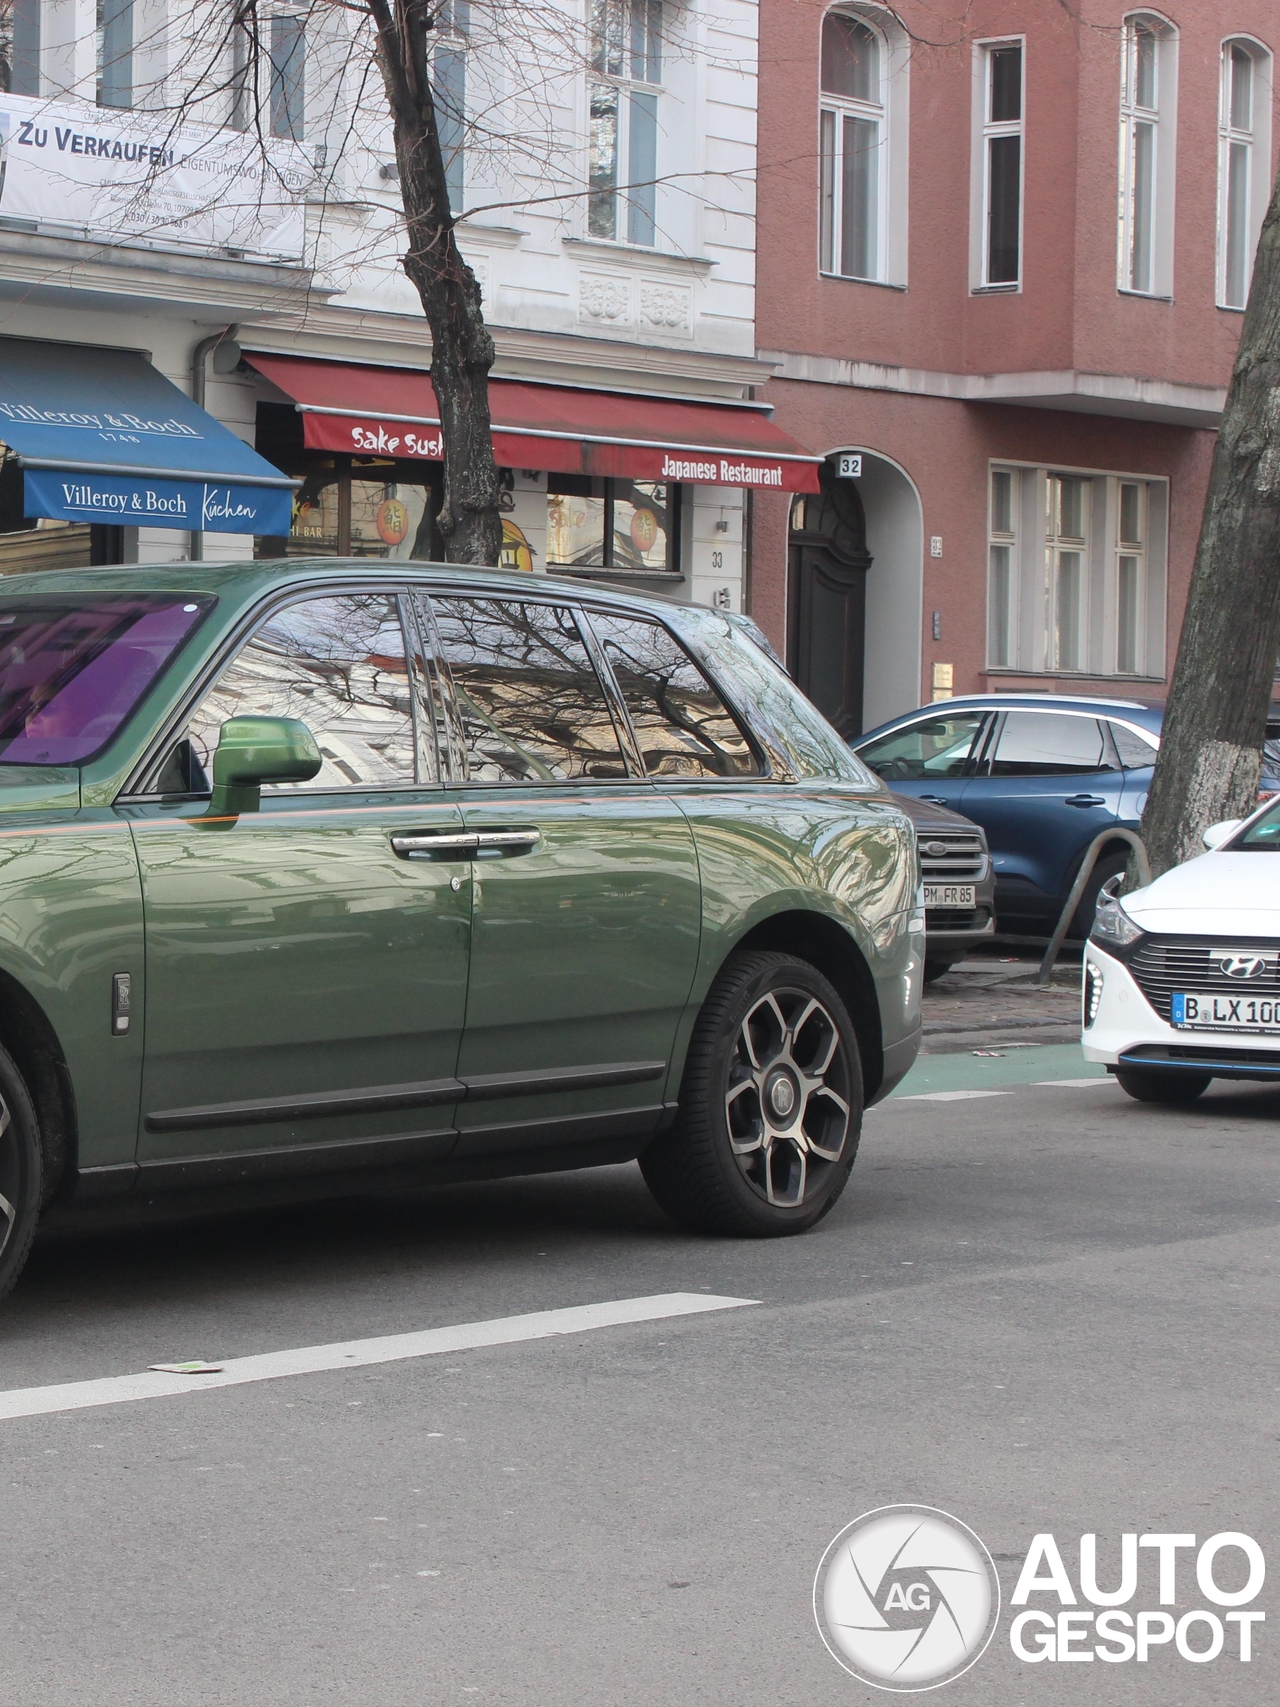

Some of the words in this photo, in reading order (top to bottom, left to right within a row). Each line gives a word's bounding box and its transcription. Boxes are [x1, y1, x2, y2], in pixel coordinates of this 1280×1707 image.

[18, 121, 48, 148] ZU
[55, 126, 175, 167] VERKAUFEN
[105, 412, 123, 429] &
[120, 412, 199, 436] Boch
[98, 432, 141, 445] 1748
[351, 425, 401, 455] Sake
[661, 454, 717, 480] Japanese
[720, 459, 783, 487] Restaurant
[842, 459, 860, 474] 32
[61, 483, 129, 514] Villeroy
[131, 493, 144, 510] &
[145, 490, 188, 514] Boch
[202, 484, 257, 530] Küchen
[303, 525, 323, 539] BAR
[711, 551, 723, 569] 33
[923, 887, 938, 903] PM
[944, 887, 958, 903] FR
[959, 887, 972, 903] 85
[1175, 1010, 1182, 1018] D
[1185, 997, 1199, 1020] B
[1213, 998, 1241, 1022] LX
